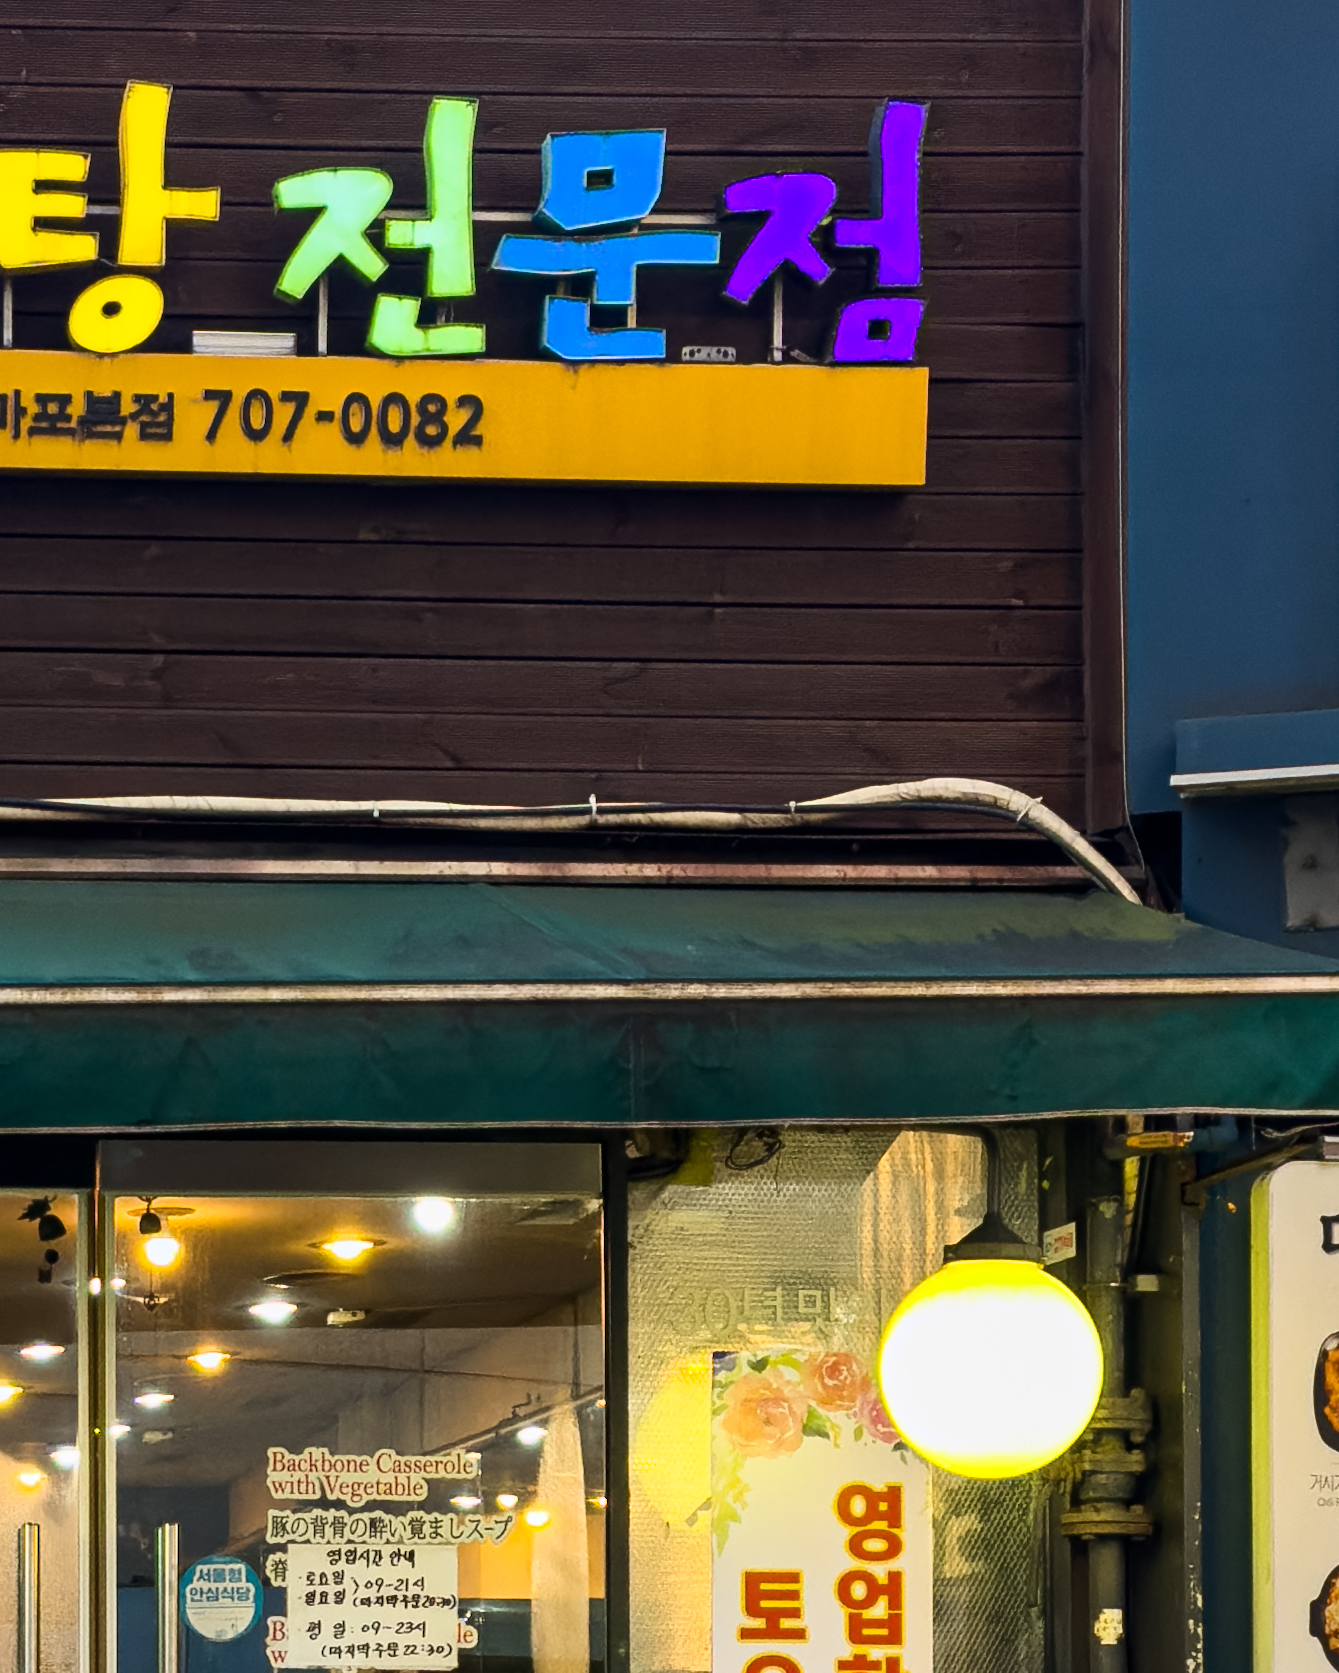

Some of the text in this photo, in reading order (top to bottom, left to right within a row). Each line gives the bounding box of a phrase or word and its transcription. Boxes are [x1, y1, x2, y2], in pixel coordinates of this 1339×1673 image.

[272, 97, 929, 363] 전문점
[203, 387, 486, 448] 707-0082
[271, 1451, 474, 1475] Backbone Casserole
[271, 1474, 424, 1503] with Vegetable
[326, 1547, 416, 1568] 영업시간 안내
[305, 1569, 346, 1587] 토요일
[189, 1585, 252, 1602] 안심식당
[304, 1588, 346, 1607] 일요일
